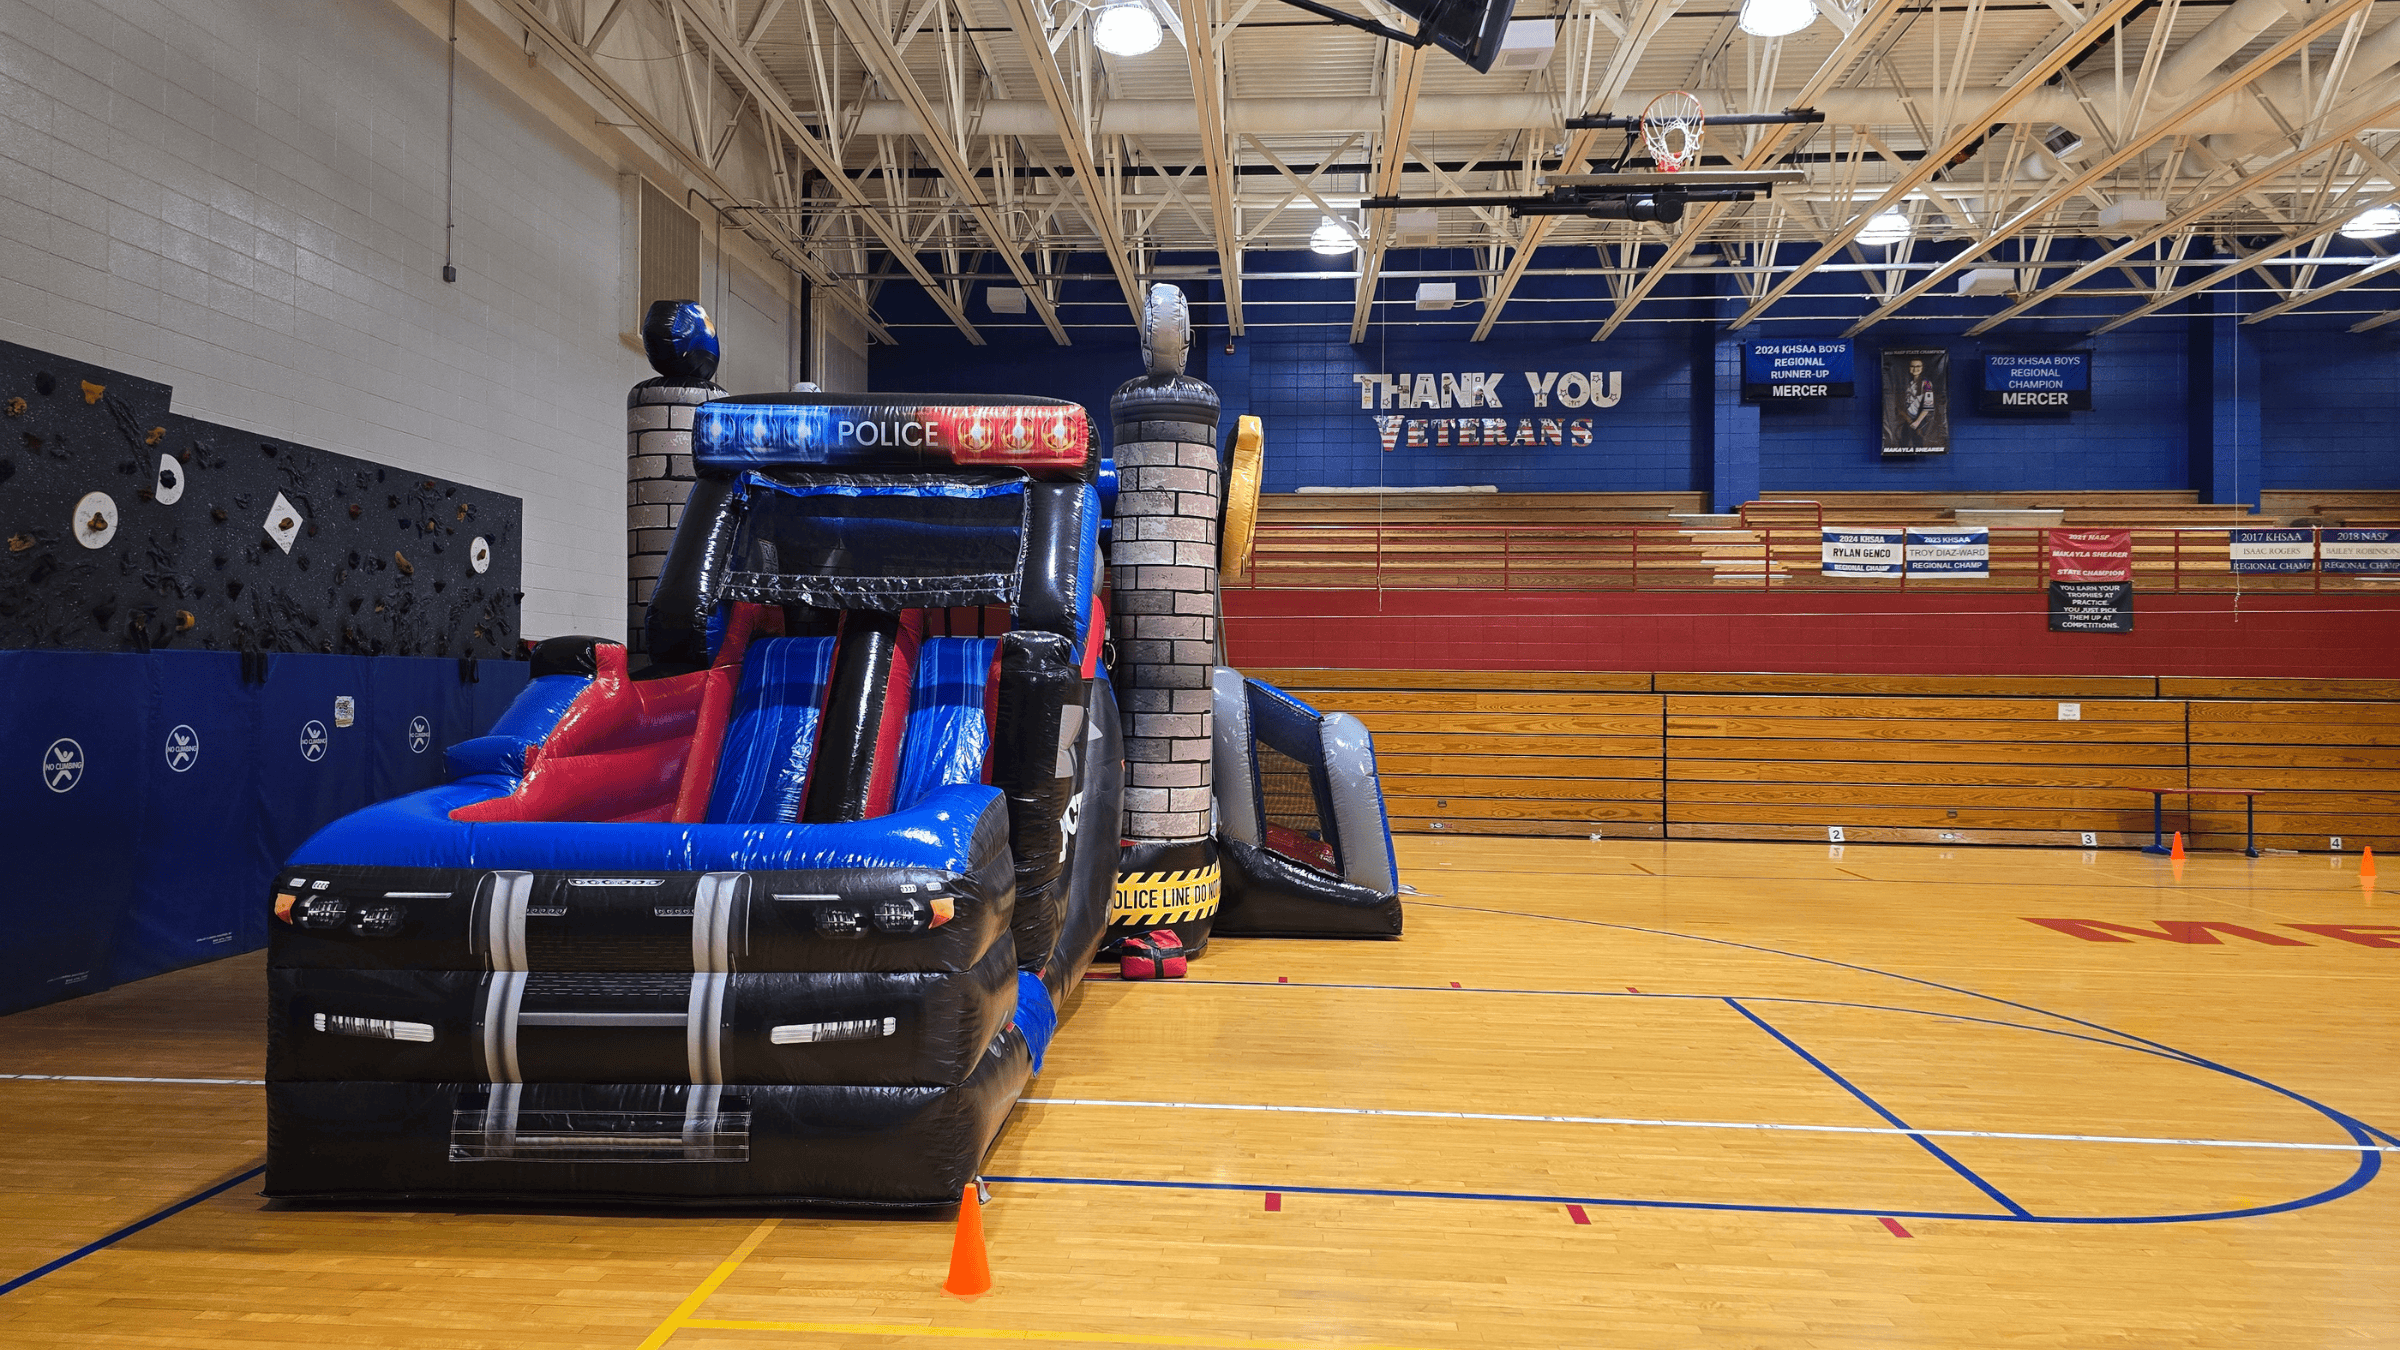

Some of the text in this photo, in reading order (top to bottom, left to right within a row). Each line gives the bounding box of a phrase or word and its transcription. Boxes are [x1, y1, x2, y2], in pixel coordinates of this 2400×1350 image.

[1755, 344, 1846, 355] 2024 KHSAA BOYS
[1774, 357, 1825, 368] REGIONAL
[1991, 356, 2081, 366] 2023 KHSAA BOYS
[1770, 369, 1830, 380] RUNNER-UP
[2010, 368, 2061, 377] REGIONAL
[1353, 370, 1622, 409] THANK YOU
[2008, 380, 2063, 389] CHAMPION
[1772, 384, 1828, 397] MERCER
[2002, 392, 2069, 405] MERCER
[838, 420, 939, 447] POLICE
[1372, 414, 1594, 452] VETERANS
[1839, 534, 1885, 544] 2024 KHSAA
[2241, 532, 2302, 541] 2017 KHSAA
[2337, 532, 2389, 541] 2018 NASP
[1833, 548, 1891, 558] RYLAN GENCO
[1909, 548, 1986, 557] TROY DIAZ-WARD
[2243, 547, 2301, 555] ISAAC ROGERS
[2326, 547, 2400, 555] BAILEY ROBINSON
[1865, 564, 1891, 572] CHAMP
[1953, 561, 1983, 569] CHAMP
[2233, 562, 2311, 570] REGIONAL CHAMP
[2324, 561, 2400, 570] REGIONAL CHAMP
[2056, 568, 2082, 576] STATE
[167, 745, 197, 753] NO CLIMBING
[46, 761, 82, 771] NO CLIMBING
[1832, 830, 1841, 840] 2
[2084, 834, 2093, 844] 3
[2332, 838, 2340, 848] 4
[1113, 889, 1158, 909] OLICE
[1163, 886, 1190, 908] LINE
[1194, 883, 1207, 904] DO
